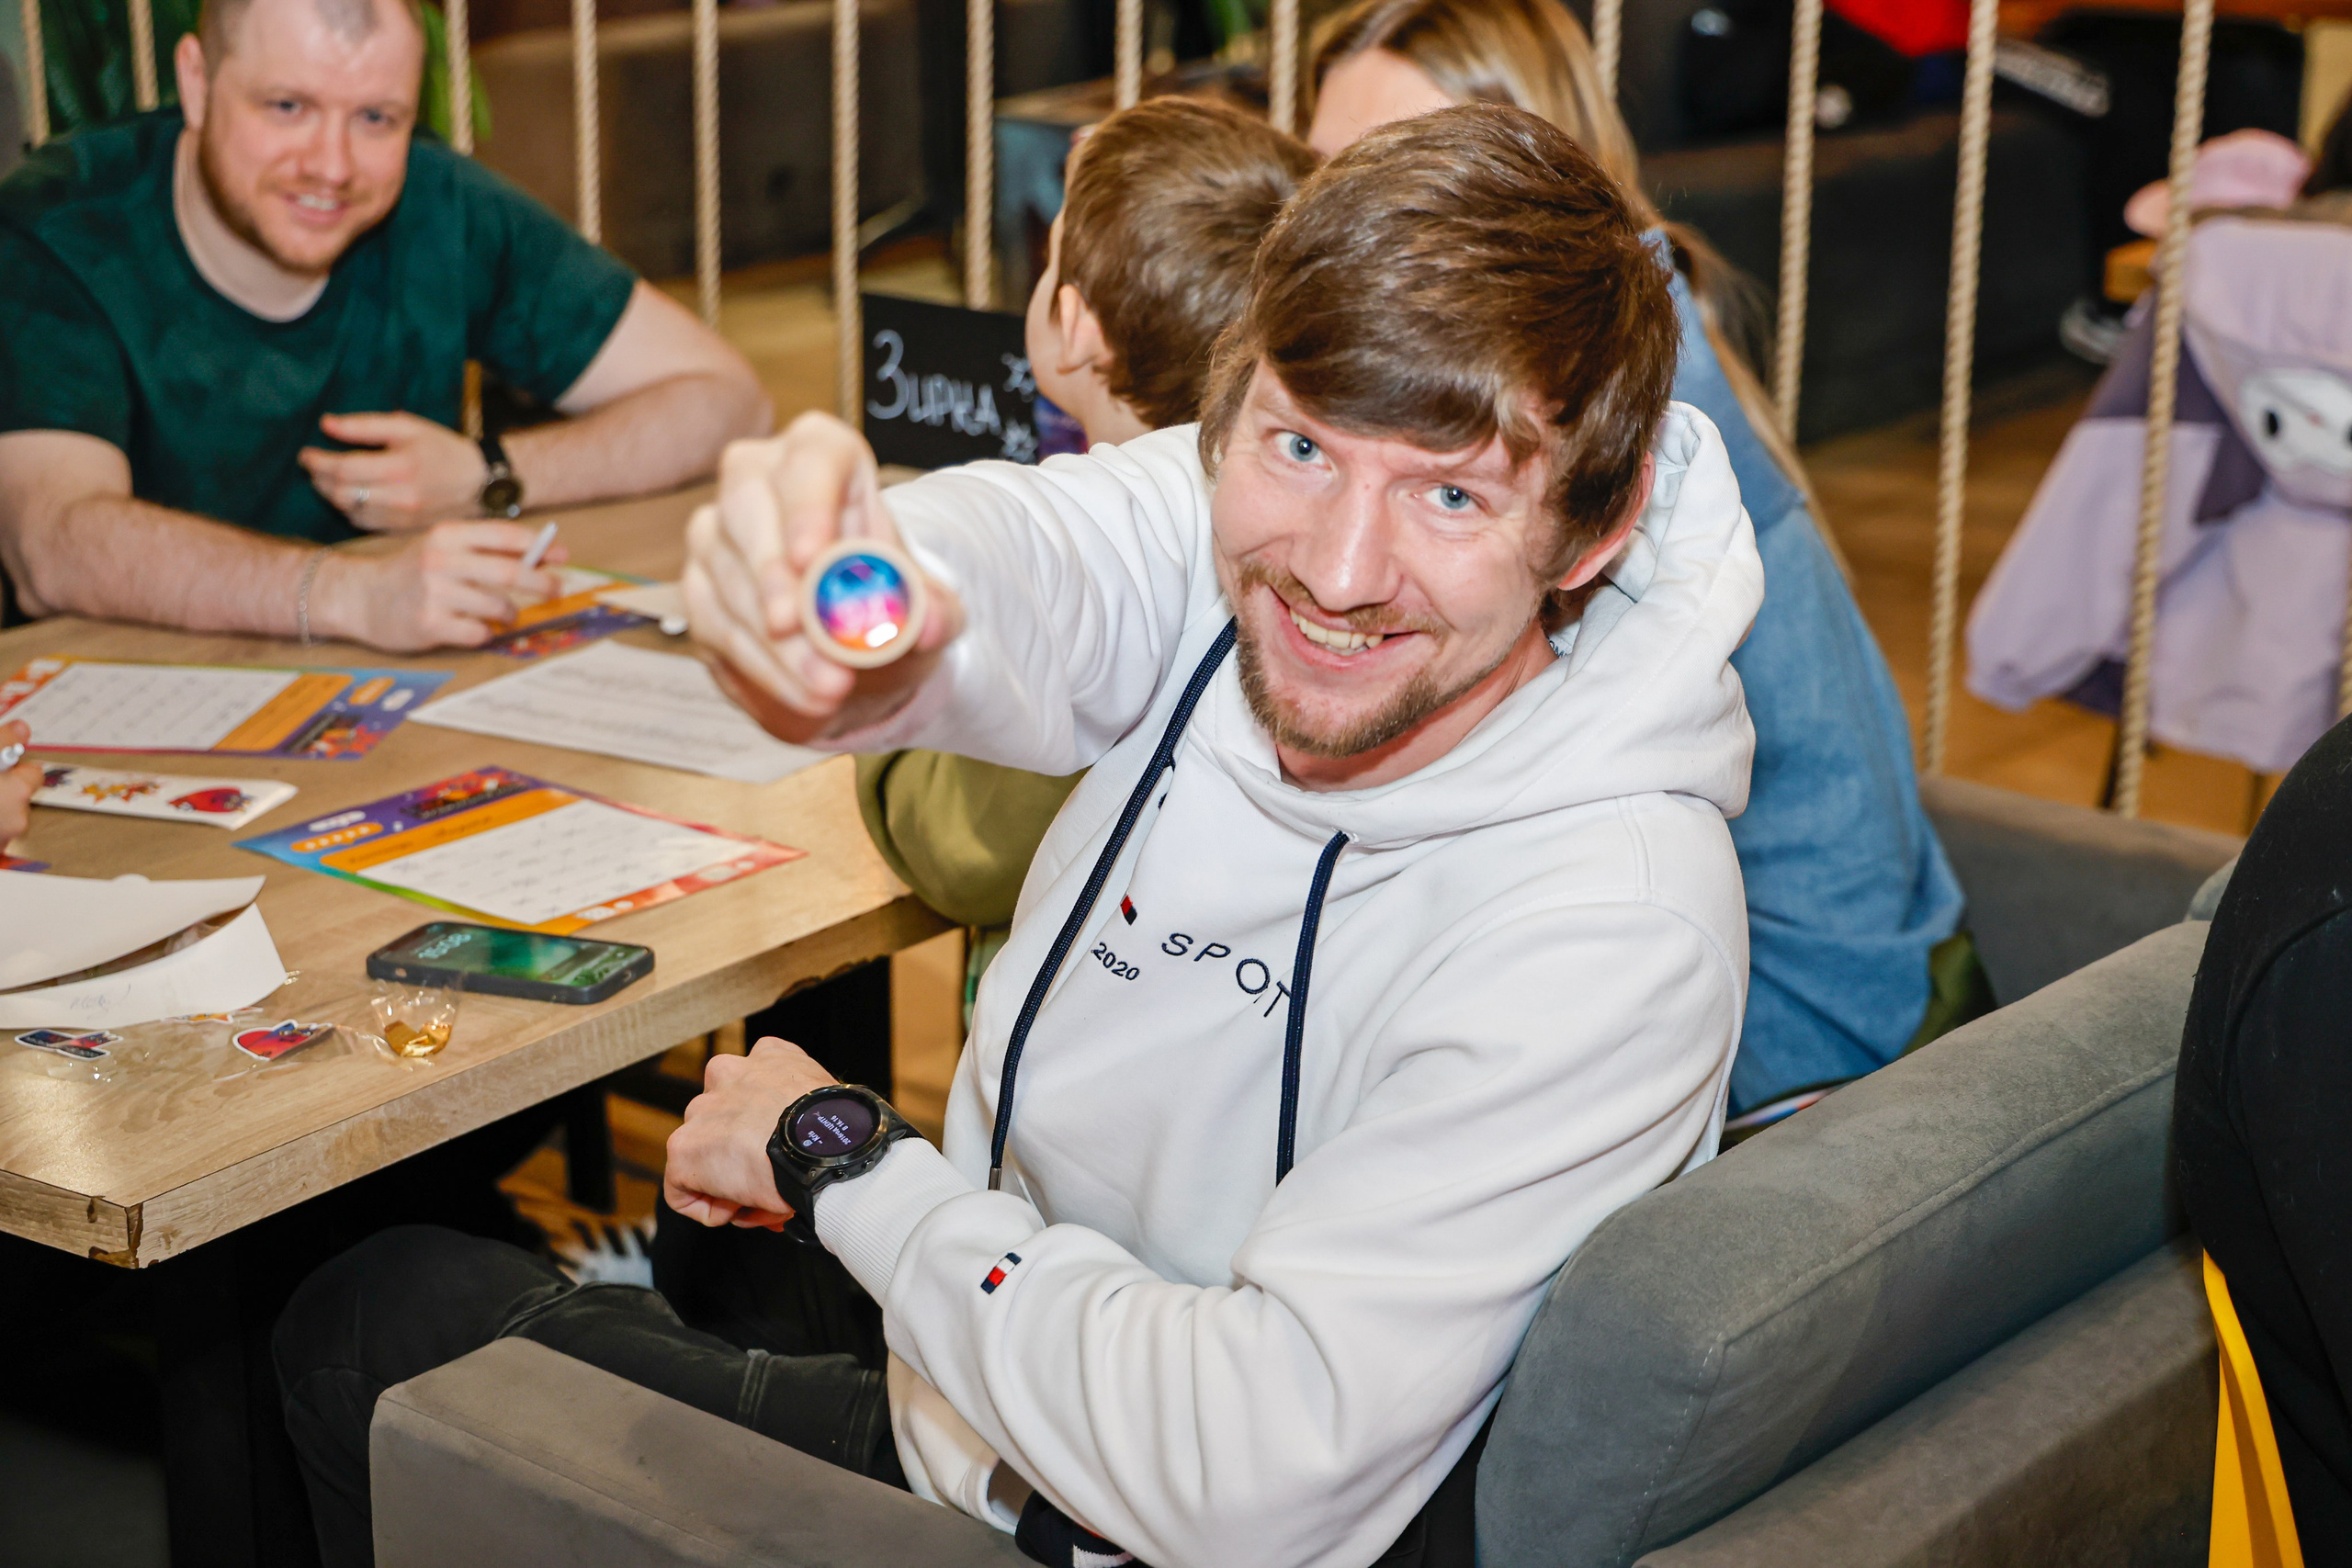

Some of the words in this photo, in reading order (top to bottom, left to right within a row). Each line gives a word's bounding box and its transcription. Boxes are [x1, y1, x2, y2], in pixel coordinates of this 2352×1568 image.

[1091, 942, 1140, 981] 2020
[818, 1116, 834, 1130] ЦЕНТР
[808, 1131, 820, 1142] Kris
